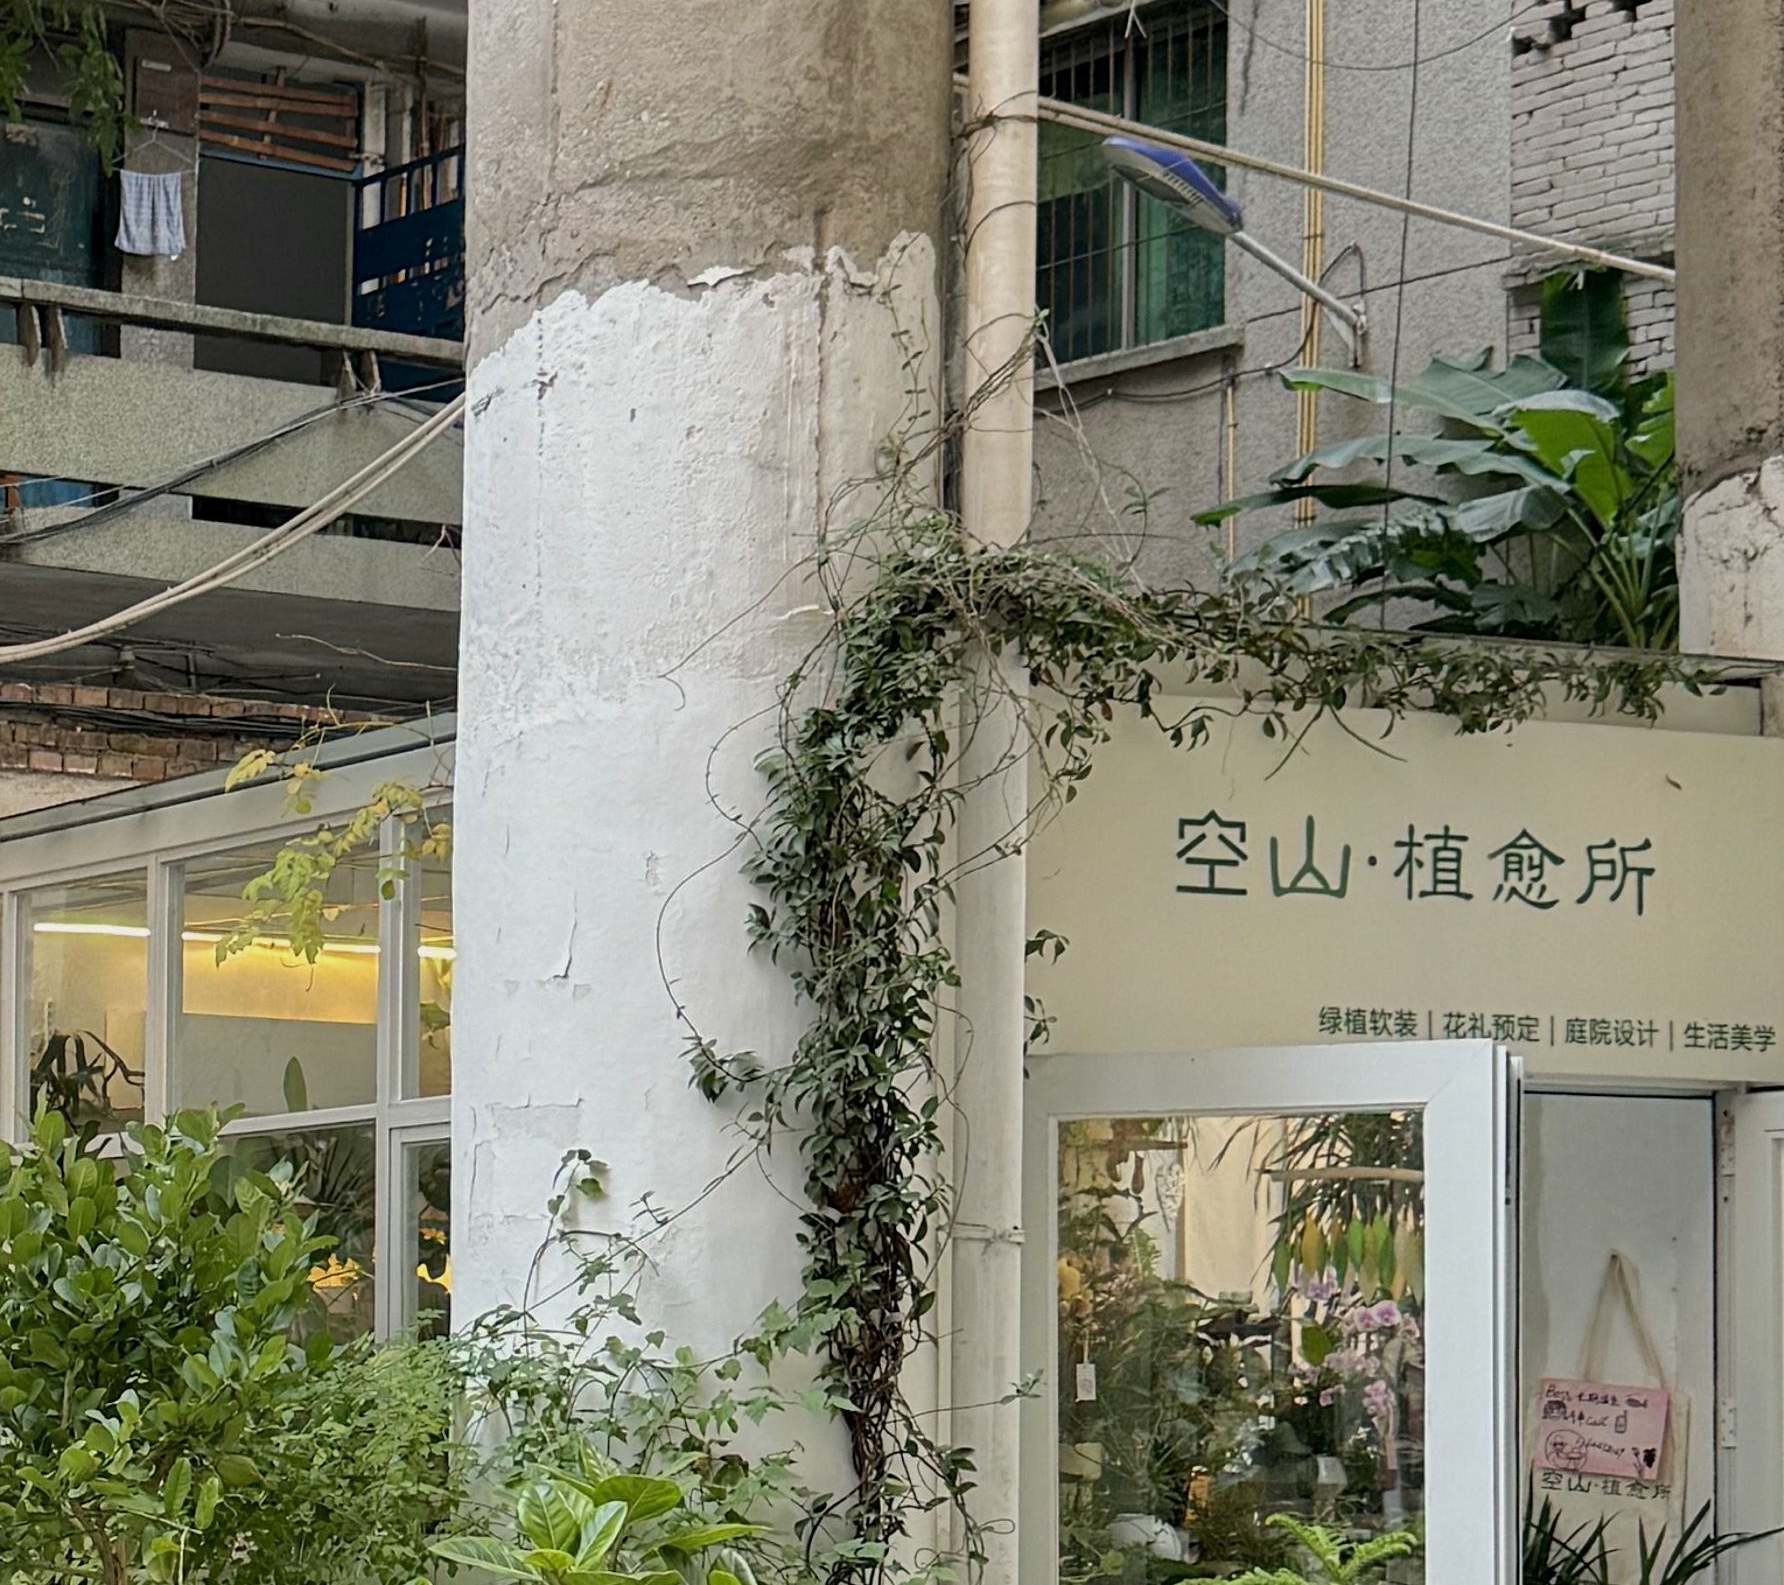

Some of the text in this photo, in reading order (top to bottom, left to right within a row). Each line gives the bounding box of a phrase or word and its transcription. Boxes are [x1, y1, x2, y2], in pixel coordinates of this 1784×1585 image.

[1175, 809, 1657, 916] 空山·植愈所
[1318, 1006, 1777, 1053] 绿植软装 花礼预定 庭院设计 生活美学
